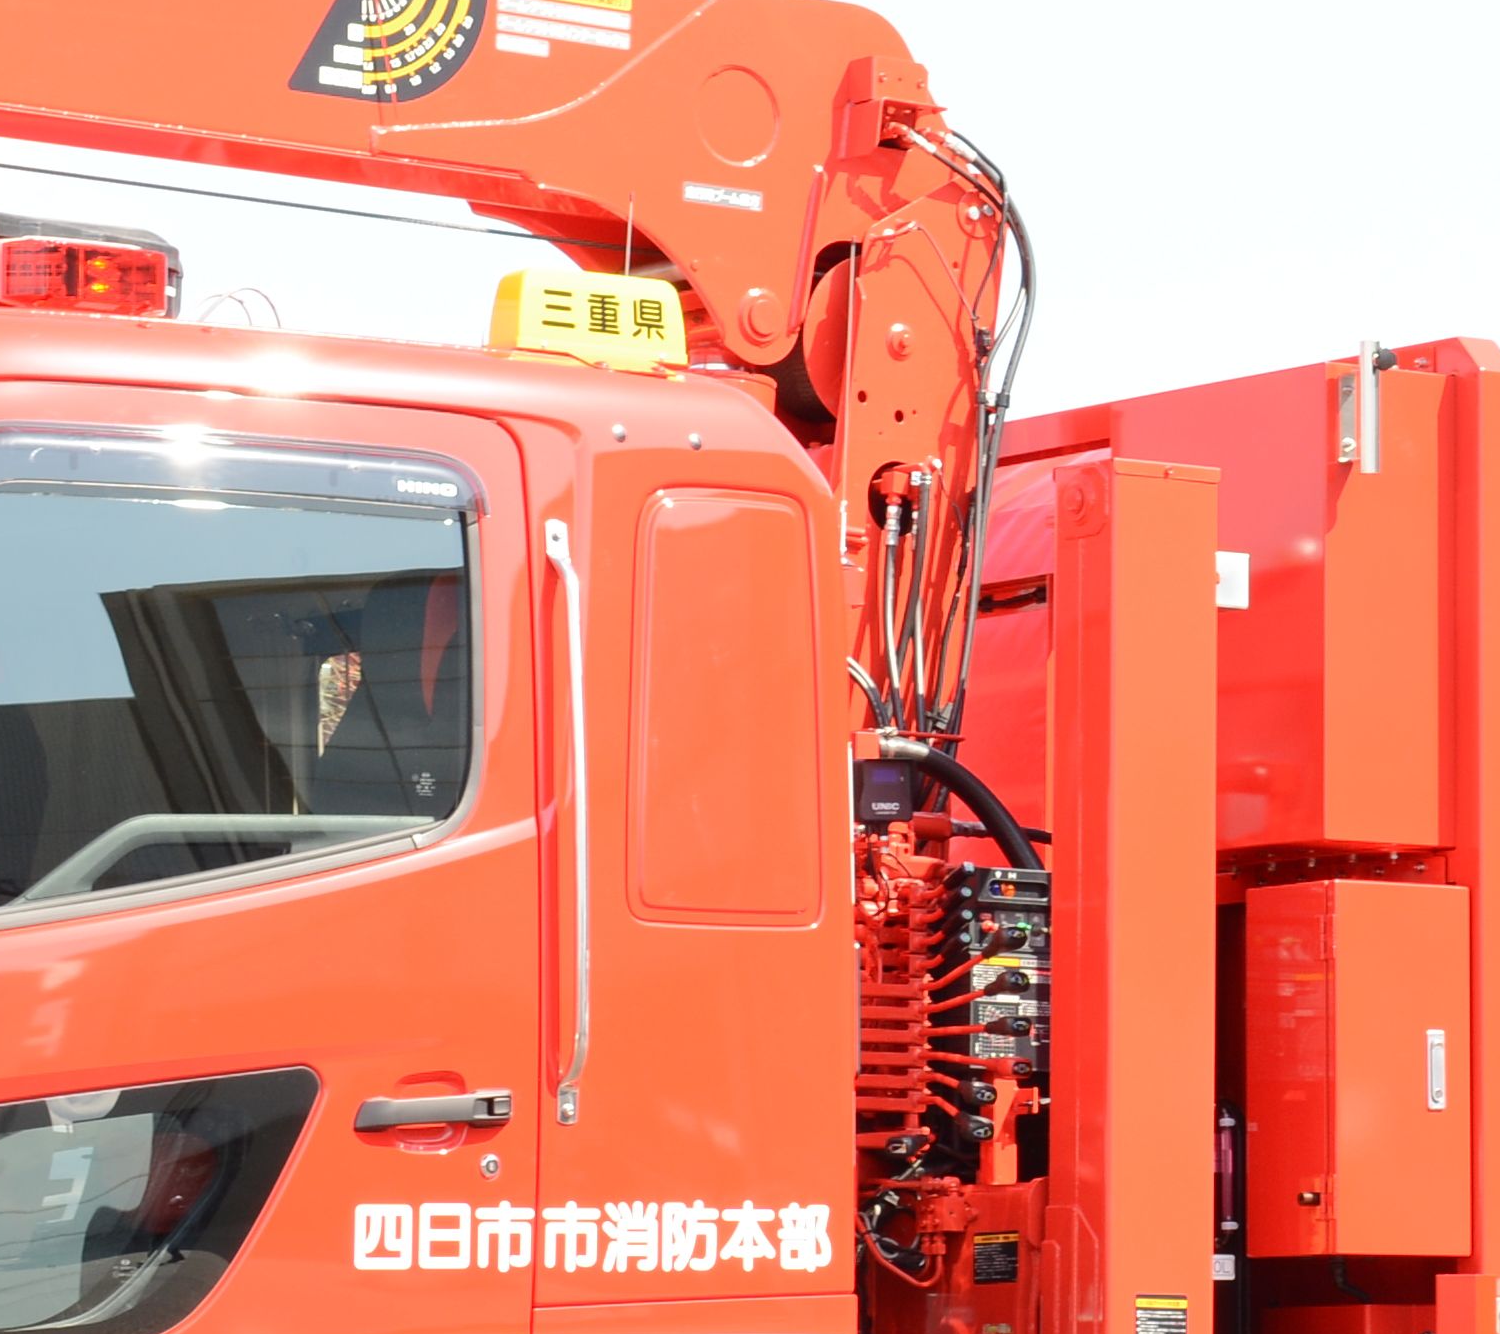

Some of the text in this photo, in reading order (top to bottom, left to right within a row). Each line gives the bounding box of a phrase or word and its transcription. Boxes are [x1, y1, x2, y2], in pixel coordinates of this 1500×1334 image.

[541, 288, 666, 341] 三重県
[396, 479, 459, 499] HINO
[353, 1199, 834, 1274] 四日市市消防本部
